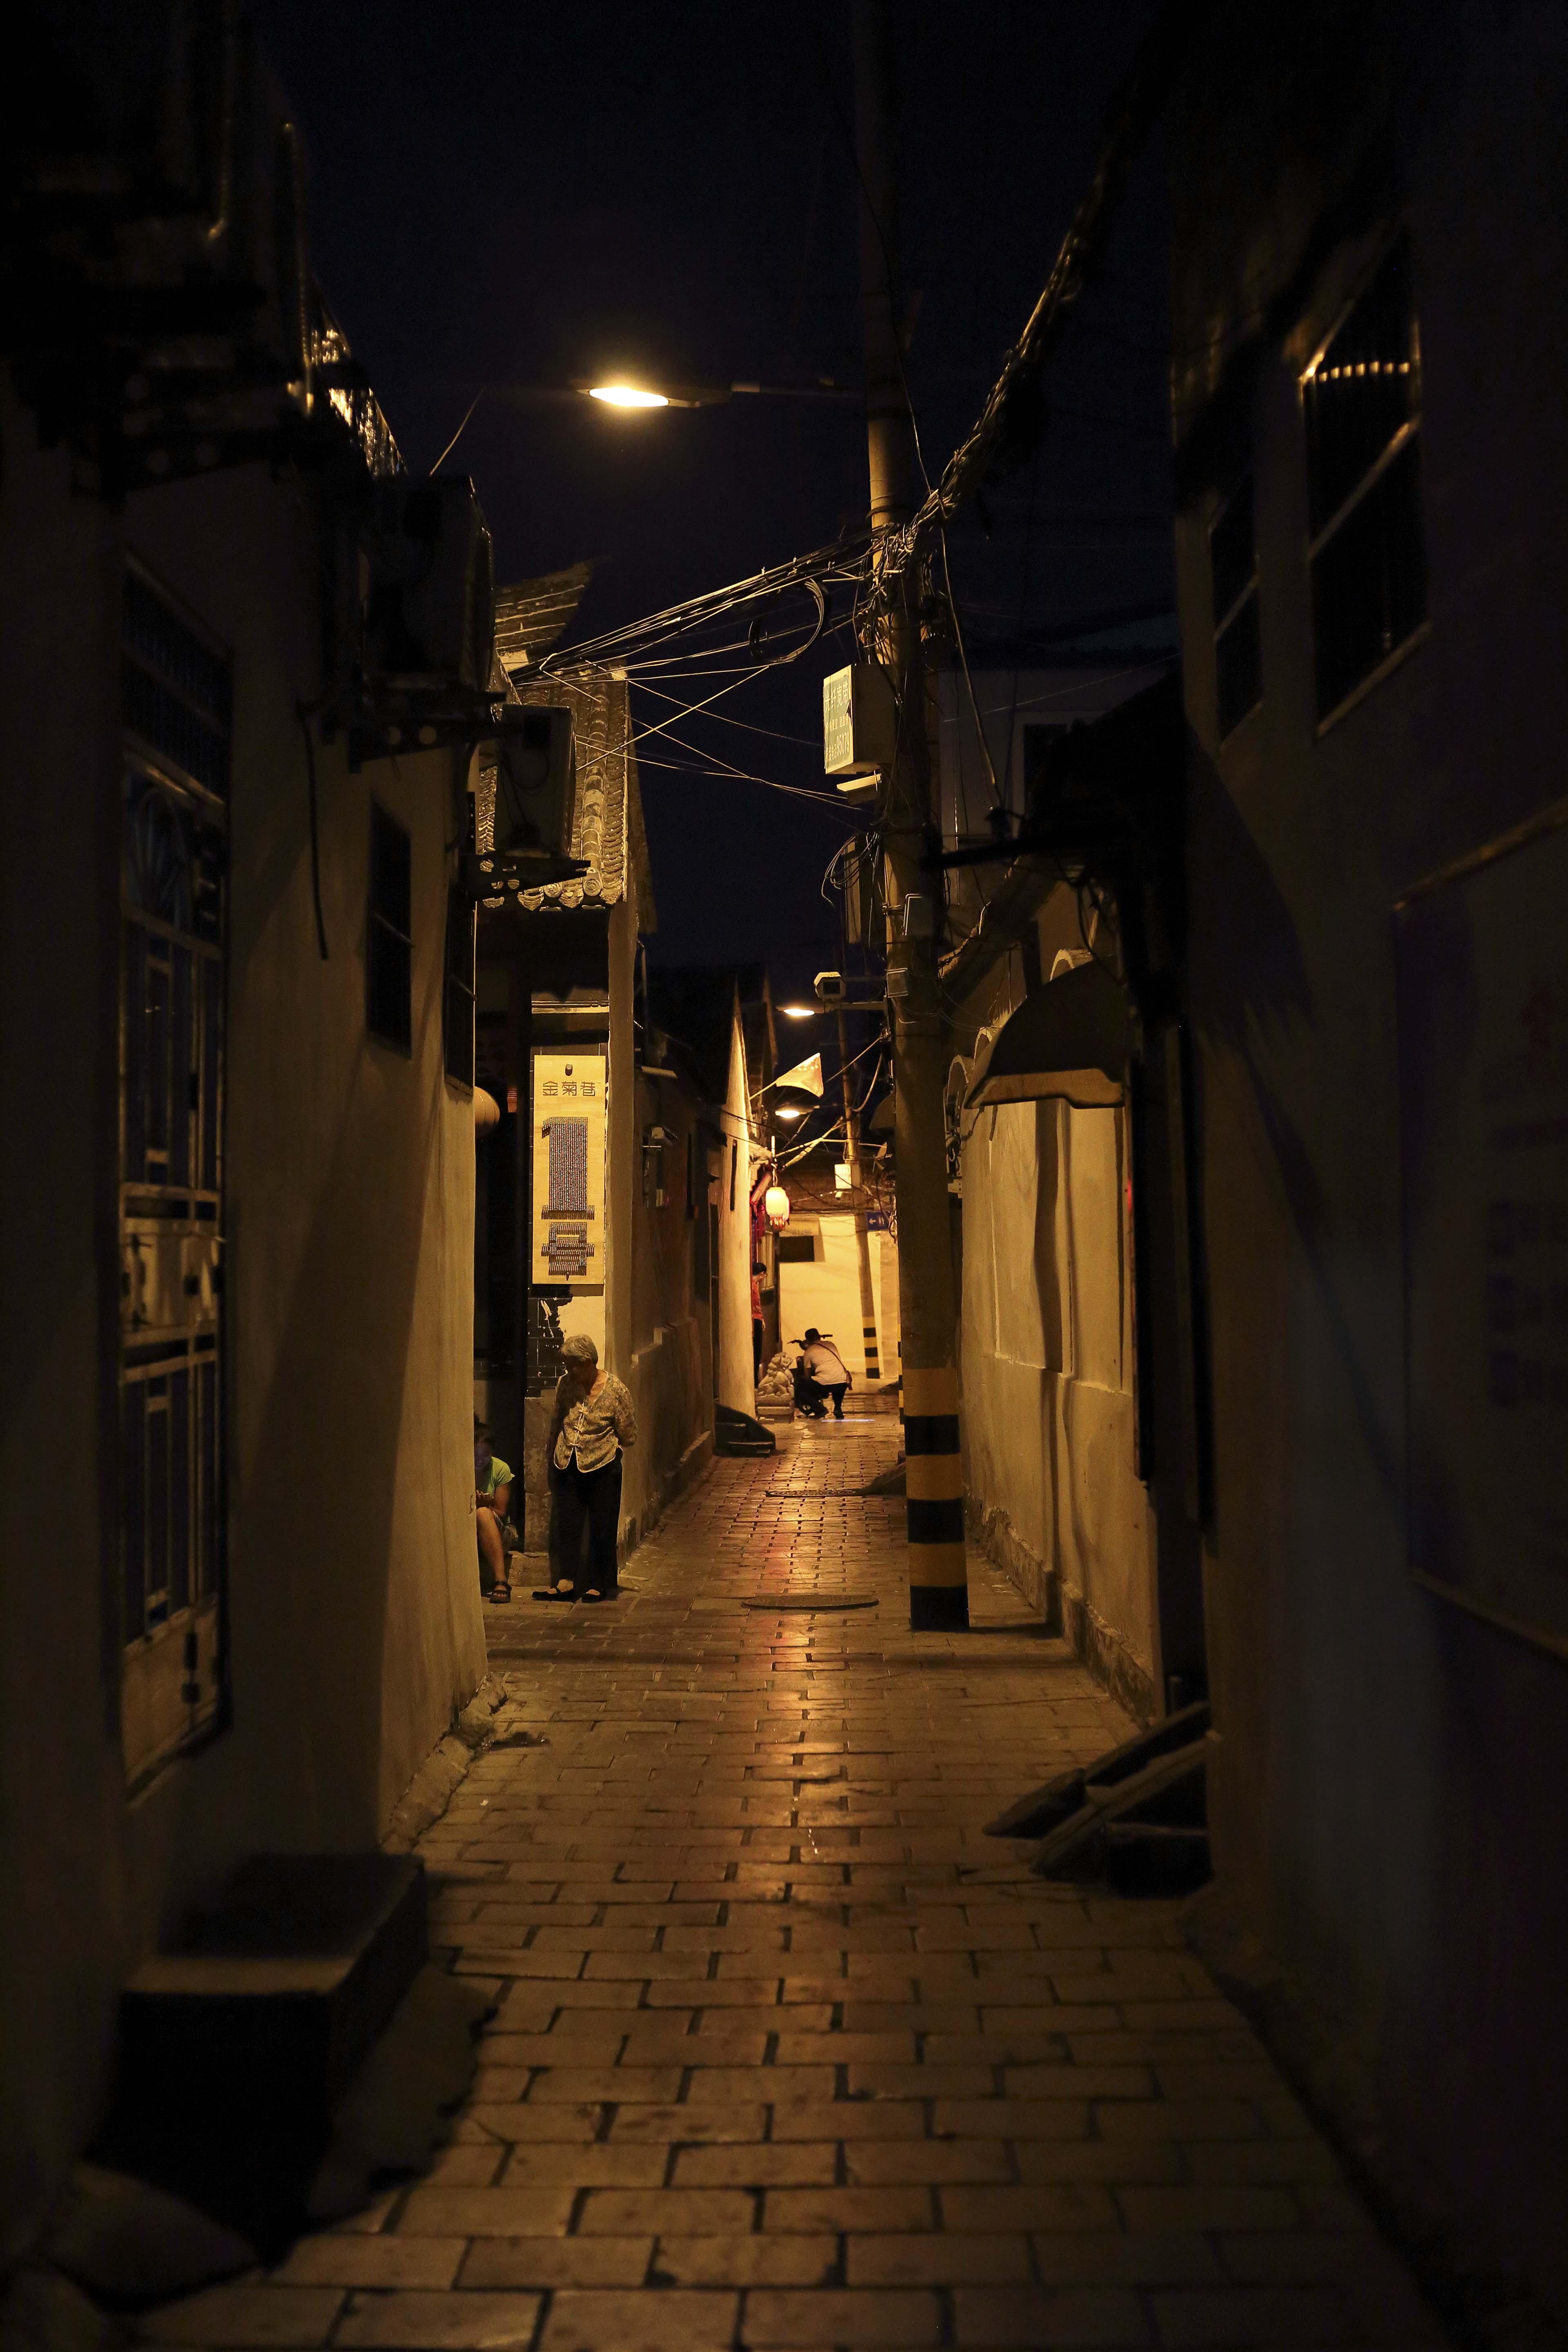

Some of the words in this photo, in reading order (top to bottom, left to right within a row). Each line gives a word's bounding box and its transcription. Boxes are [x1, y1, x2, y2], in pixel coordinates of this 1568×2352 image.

[825, 682, 848, 712] 光纤宽带
[837, 731, 849, 756] 95079
[543, 1081, 595, 1096] 金菊巷
